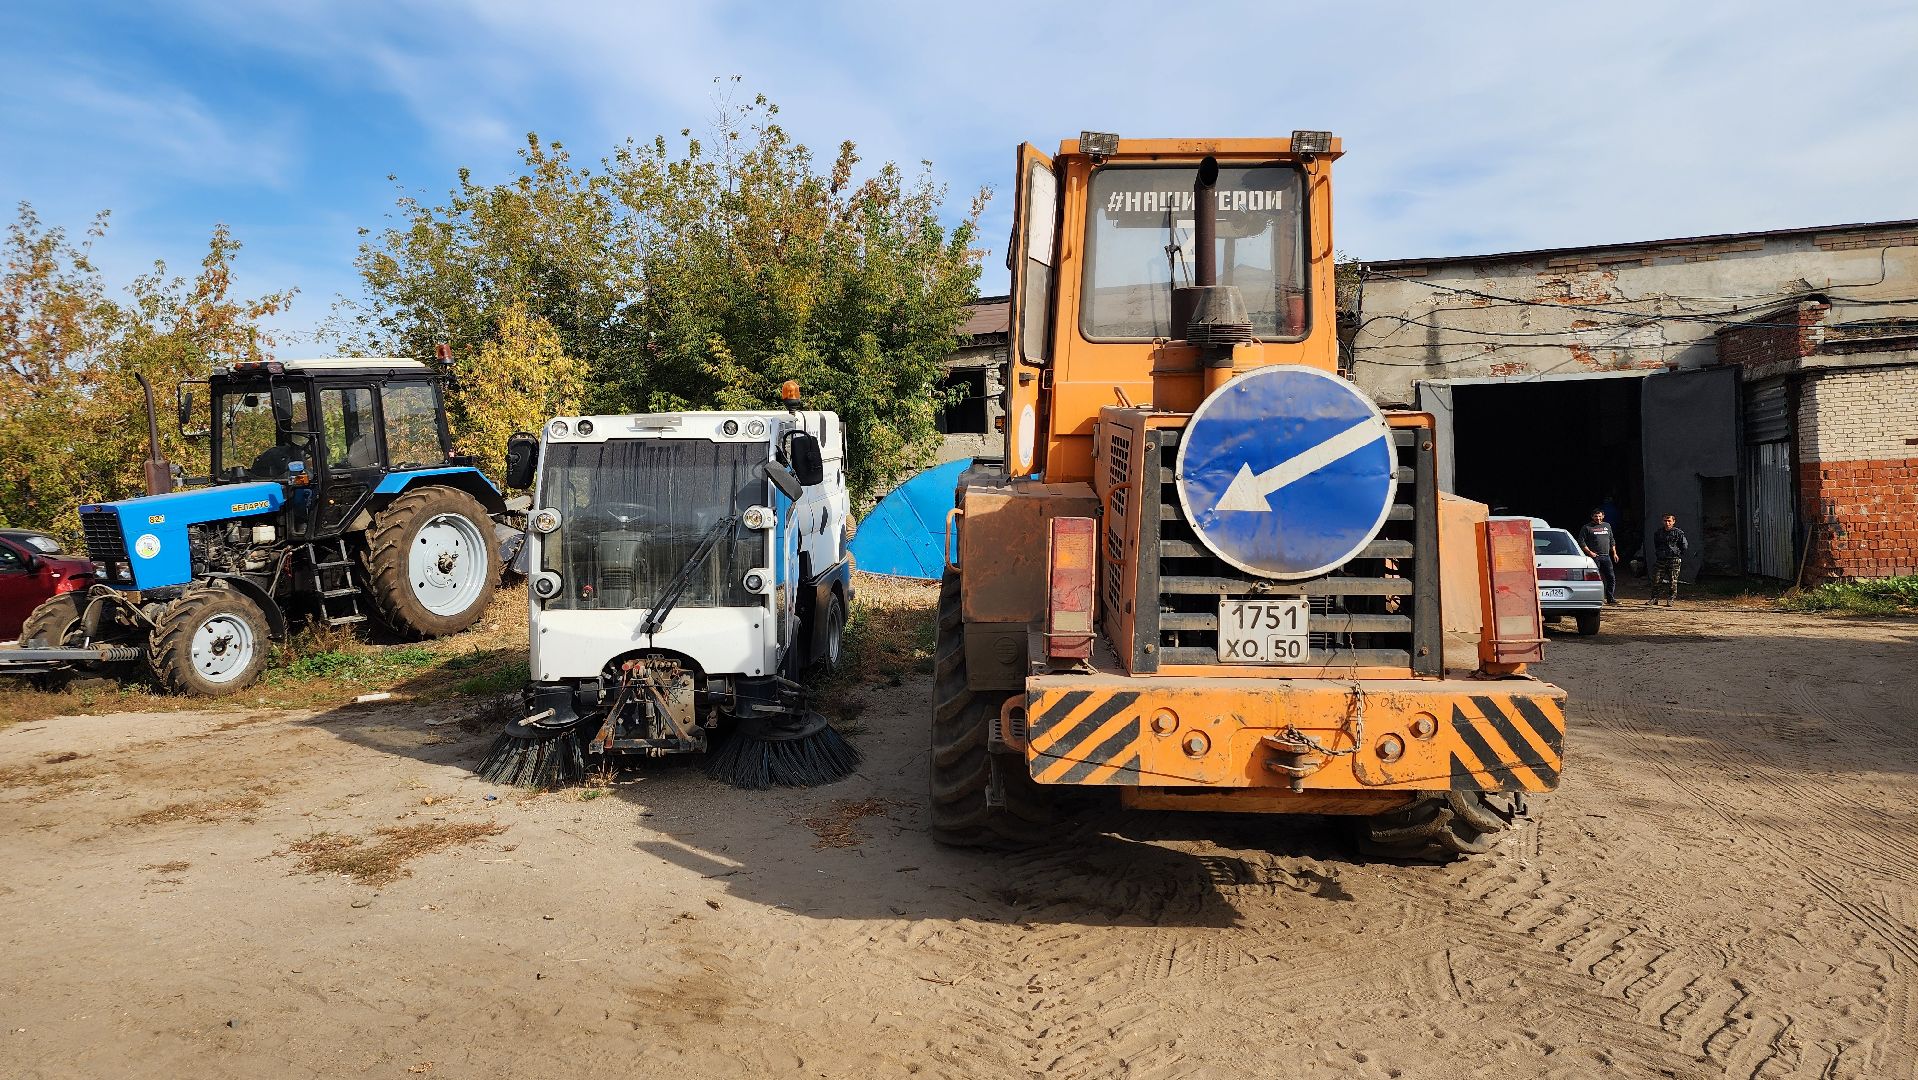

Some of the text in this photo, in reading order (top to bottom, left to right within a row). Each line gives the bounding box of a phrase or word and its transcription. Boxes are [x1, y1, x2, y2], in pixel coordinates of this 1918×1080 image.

[1107, 190, 1283, 212] #НАШИЕРОИ
[231, 500, 270, 512] БЕЛАРУС
[1231, 604, 1297, 630] 1751
[1226, 639, 1301, 659] ХО 50
